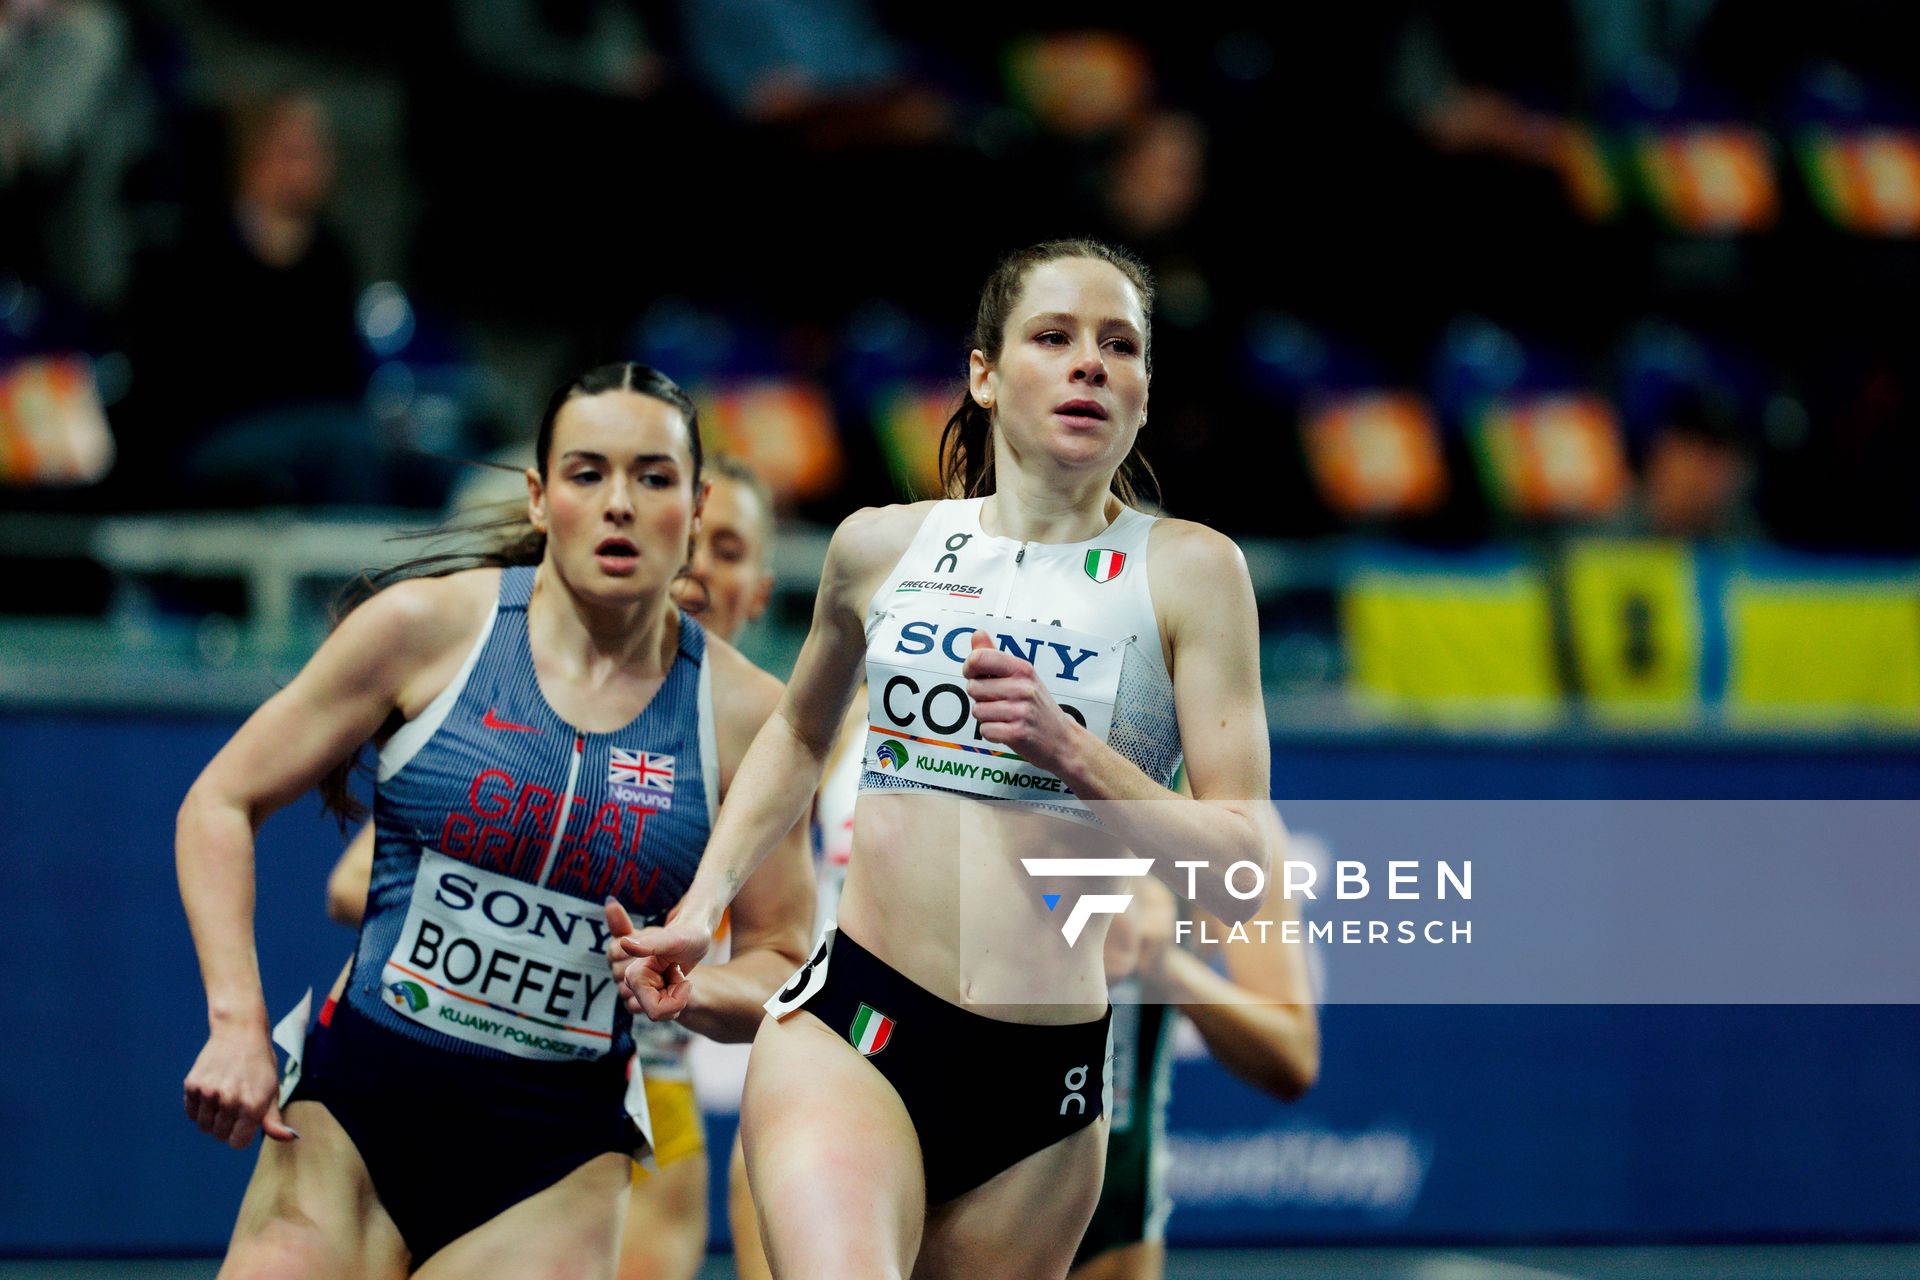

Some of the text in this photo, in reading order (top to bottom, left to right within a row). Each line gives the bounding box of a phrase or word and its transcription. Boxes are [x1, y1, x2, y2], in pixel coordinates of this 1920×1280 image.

[898, 581, 984, 595] FRECCIAROSSA
[608, 783, 672, 811] Novuna
[916, 755, 1061, 793] KUJAWY POMORZE
[468, 769, 657, 853] GREAT
[438, 813, 662, 905] BRITAIN
[435, 872, 611, 955] SONY
[409, 919, 610, 1022] BOFFEY
[438, 1004, 504, 1038] KUJAWY
[503, 1026, 578, 1055] POMORZE
